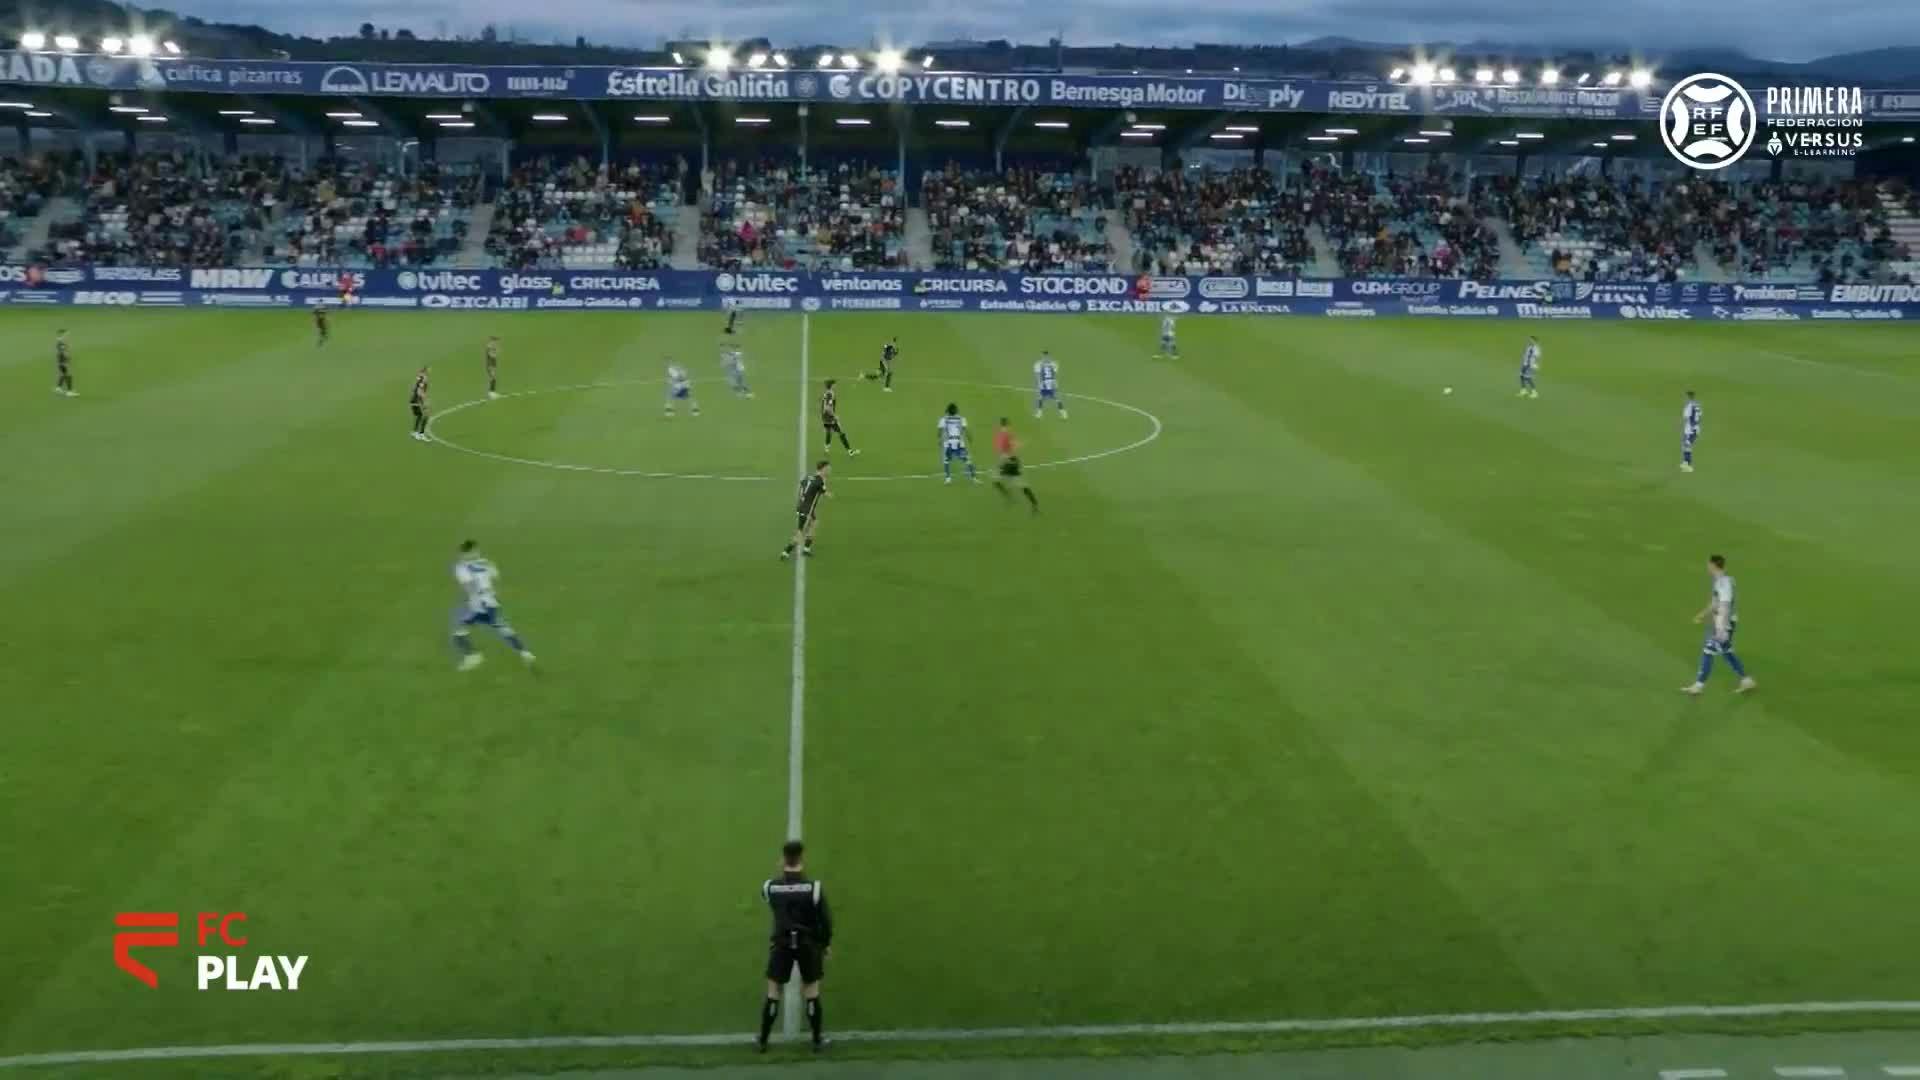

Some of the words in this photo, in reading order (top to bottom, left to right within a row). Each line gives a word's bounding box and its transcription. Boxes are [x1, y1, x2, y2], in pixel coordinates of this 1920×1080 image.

[228, 68, 304, 86] pizarras
[371, 72, 490, 93] LEMAUTO
[606, 71, 699, 96] Estrella
[703, 73, 789, 98] Galicia
[858, 75, 1040, 101] COPYCENTRO
[1051, 79, 1144, 106] Bernesga
[1147, 83, 1206, 103] Motor
[190, 268, 274, 289] MRW
[417, 271, 481, 291] tvitec
[500, 273, 553, 294] glass
[570, 276, 661, 291] CRICURSA
[735, 273, 798, 292] tvitec
[821, 276, 903, 291] ventanas
[922, 278, 1008, 293] CRICURSA
[1636, 305, 1692, 319] tvitec
